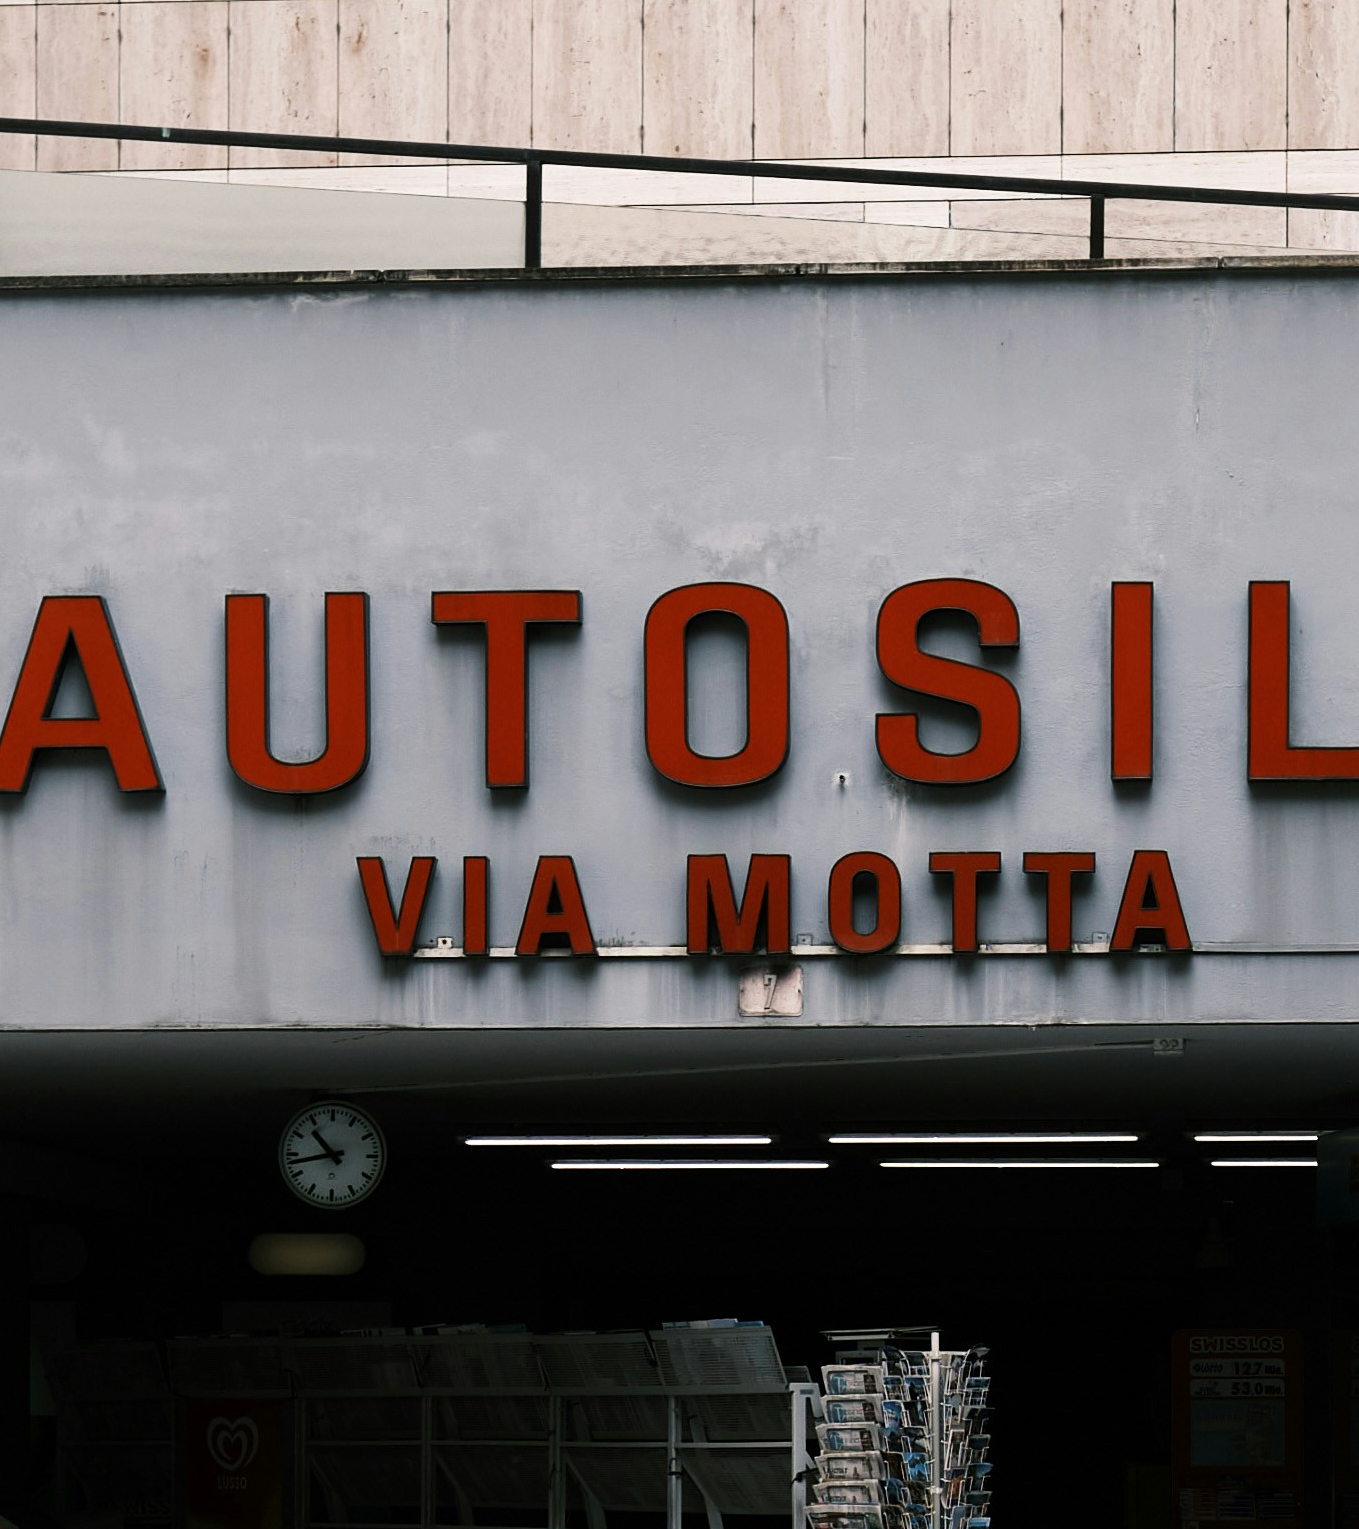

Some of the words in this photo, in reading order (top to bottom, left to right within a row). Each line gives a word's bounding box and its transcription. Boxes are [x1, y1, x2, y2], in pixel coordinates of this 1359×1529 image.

[356, 855, 598, 957] VIA
[685, 849, 1192, 953] MOTTA
[763, 974, 778, 1010] 7
[1190, 1336, 1284, 1353] SWISSLOS
[1233, 1361, 1264, 1375] 12.7
[1231, 1382, 1263, 1396] 53.0
[217, 1475, 248, 1490] LUSSO
